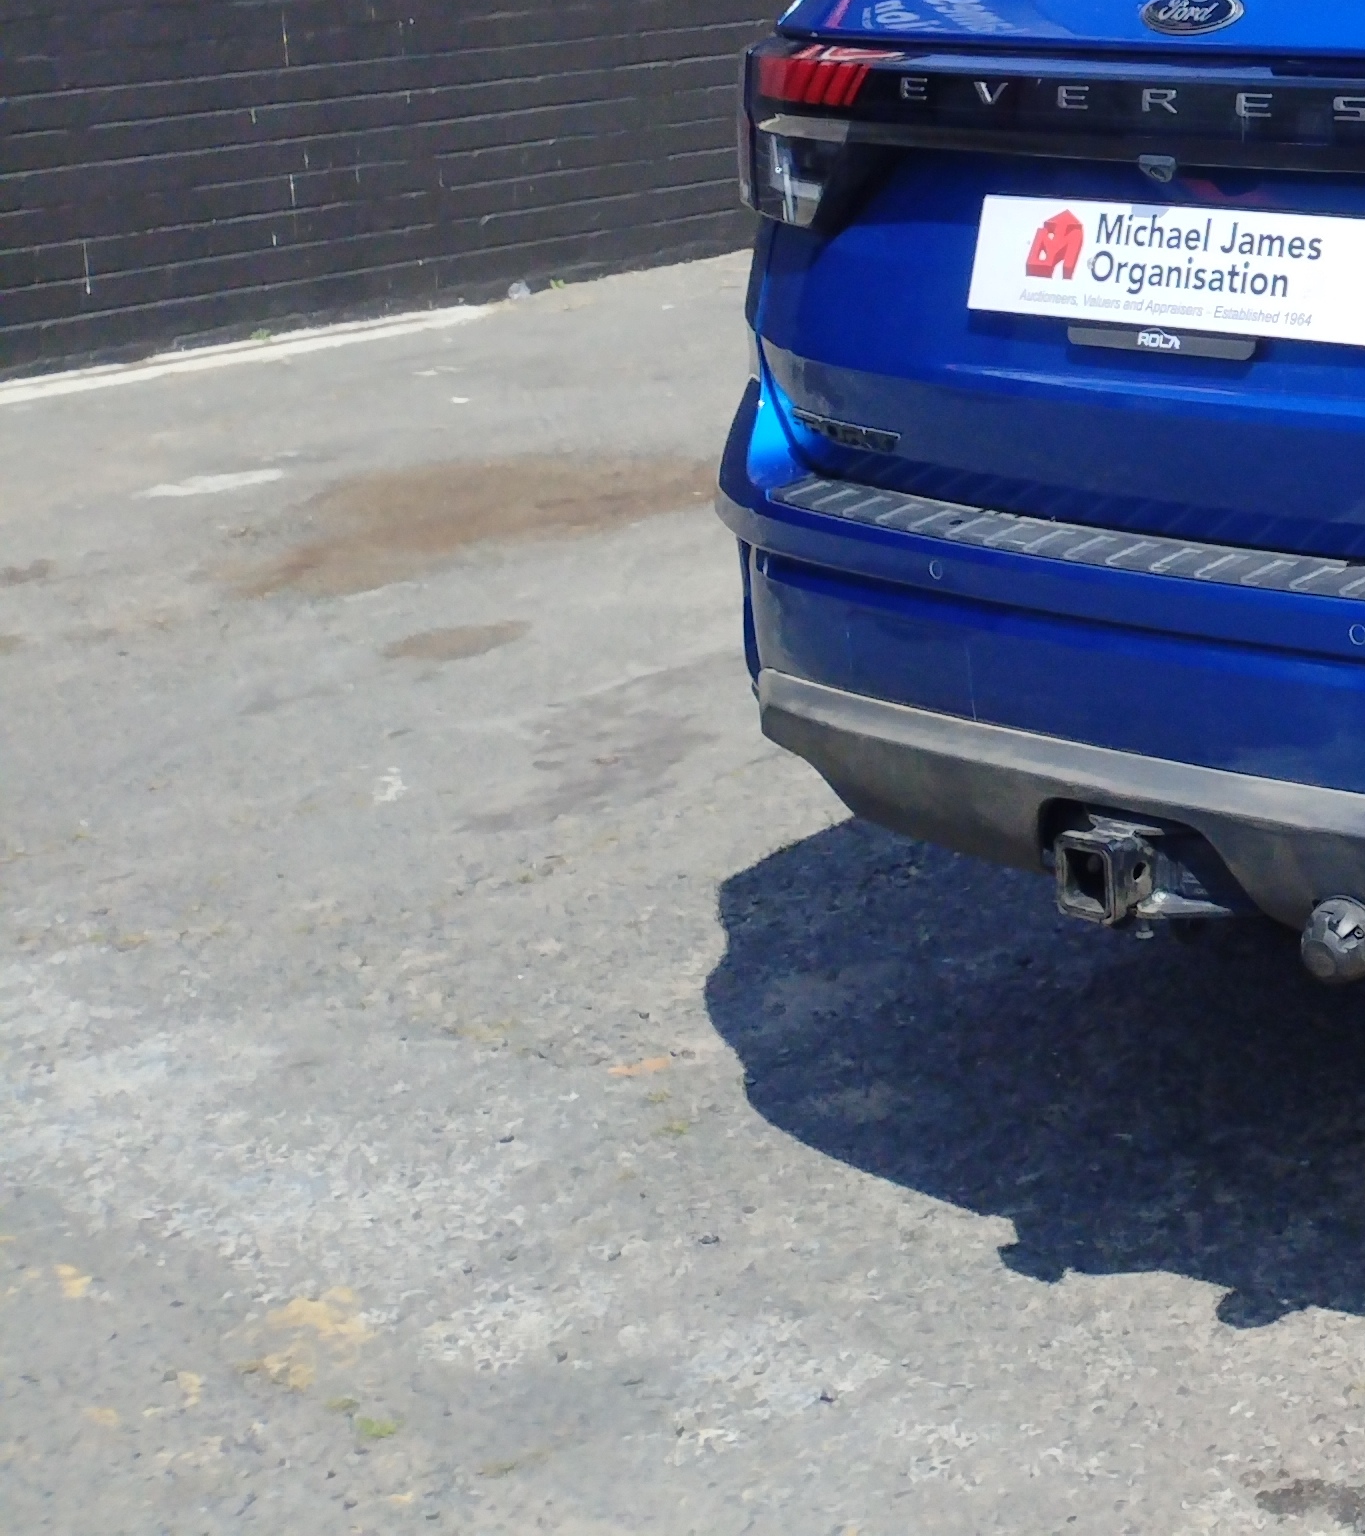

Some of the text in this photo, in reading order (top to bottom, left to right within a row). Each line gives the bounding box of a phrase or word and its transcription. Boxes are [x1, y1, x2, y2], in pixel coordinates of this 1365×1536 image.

[1095, 212, 1323, 260] Michael James
[1090, 251, 1289, 298] Organisation
[1020, 289, 1079, 307] Auctioneers,
[1083, 294, 1121, 310] Valuers
[1123, 297, 1144, 312] and
[1145, 299, 1203, 319] Appraisers
[1213, 305, 1280, 324] Established
[1283, 311, 1313, 327] 1964
[1137, 328, 1181, 349] ROLA
